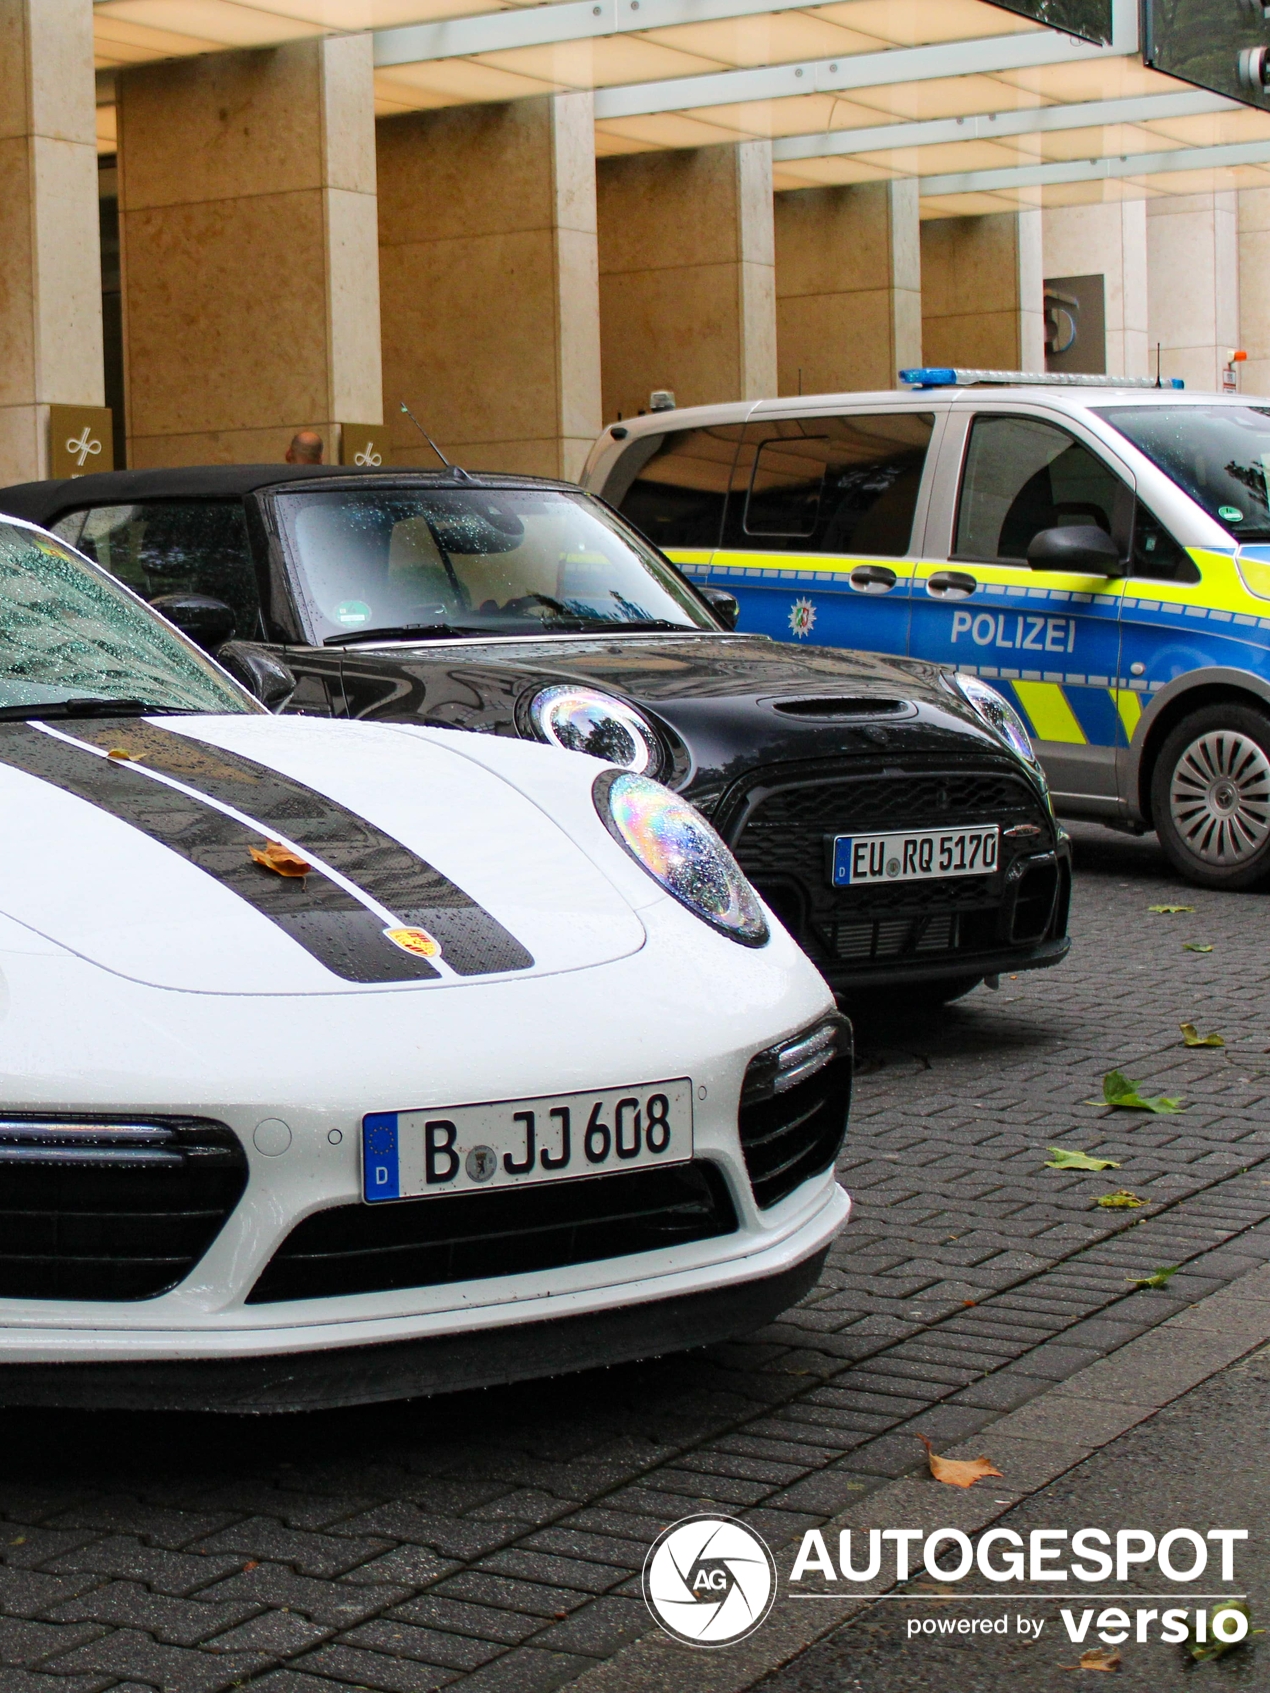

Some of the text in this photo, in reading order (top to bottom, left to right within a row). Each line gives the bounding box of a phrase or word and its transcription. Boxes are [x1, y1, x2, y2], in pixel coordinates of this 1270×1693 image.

[950, 611, 1076, 653] POLIZEI
[838, 833, 996, 878] D EU RQ 5170
[375, 1093, 671, 1185] D B JJ 608
